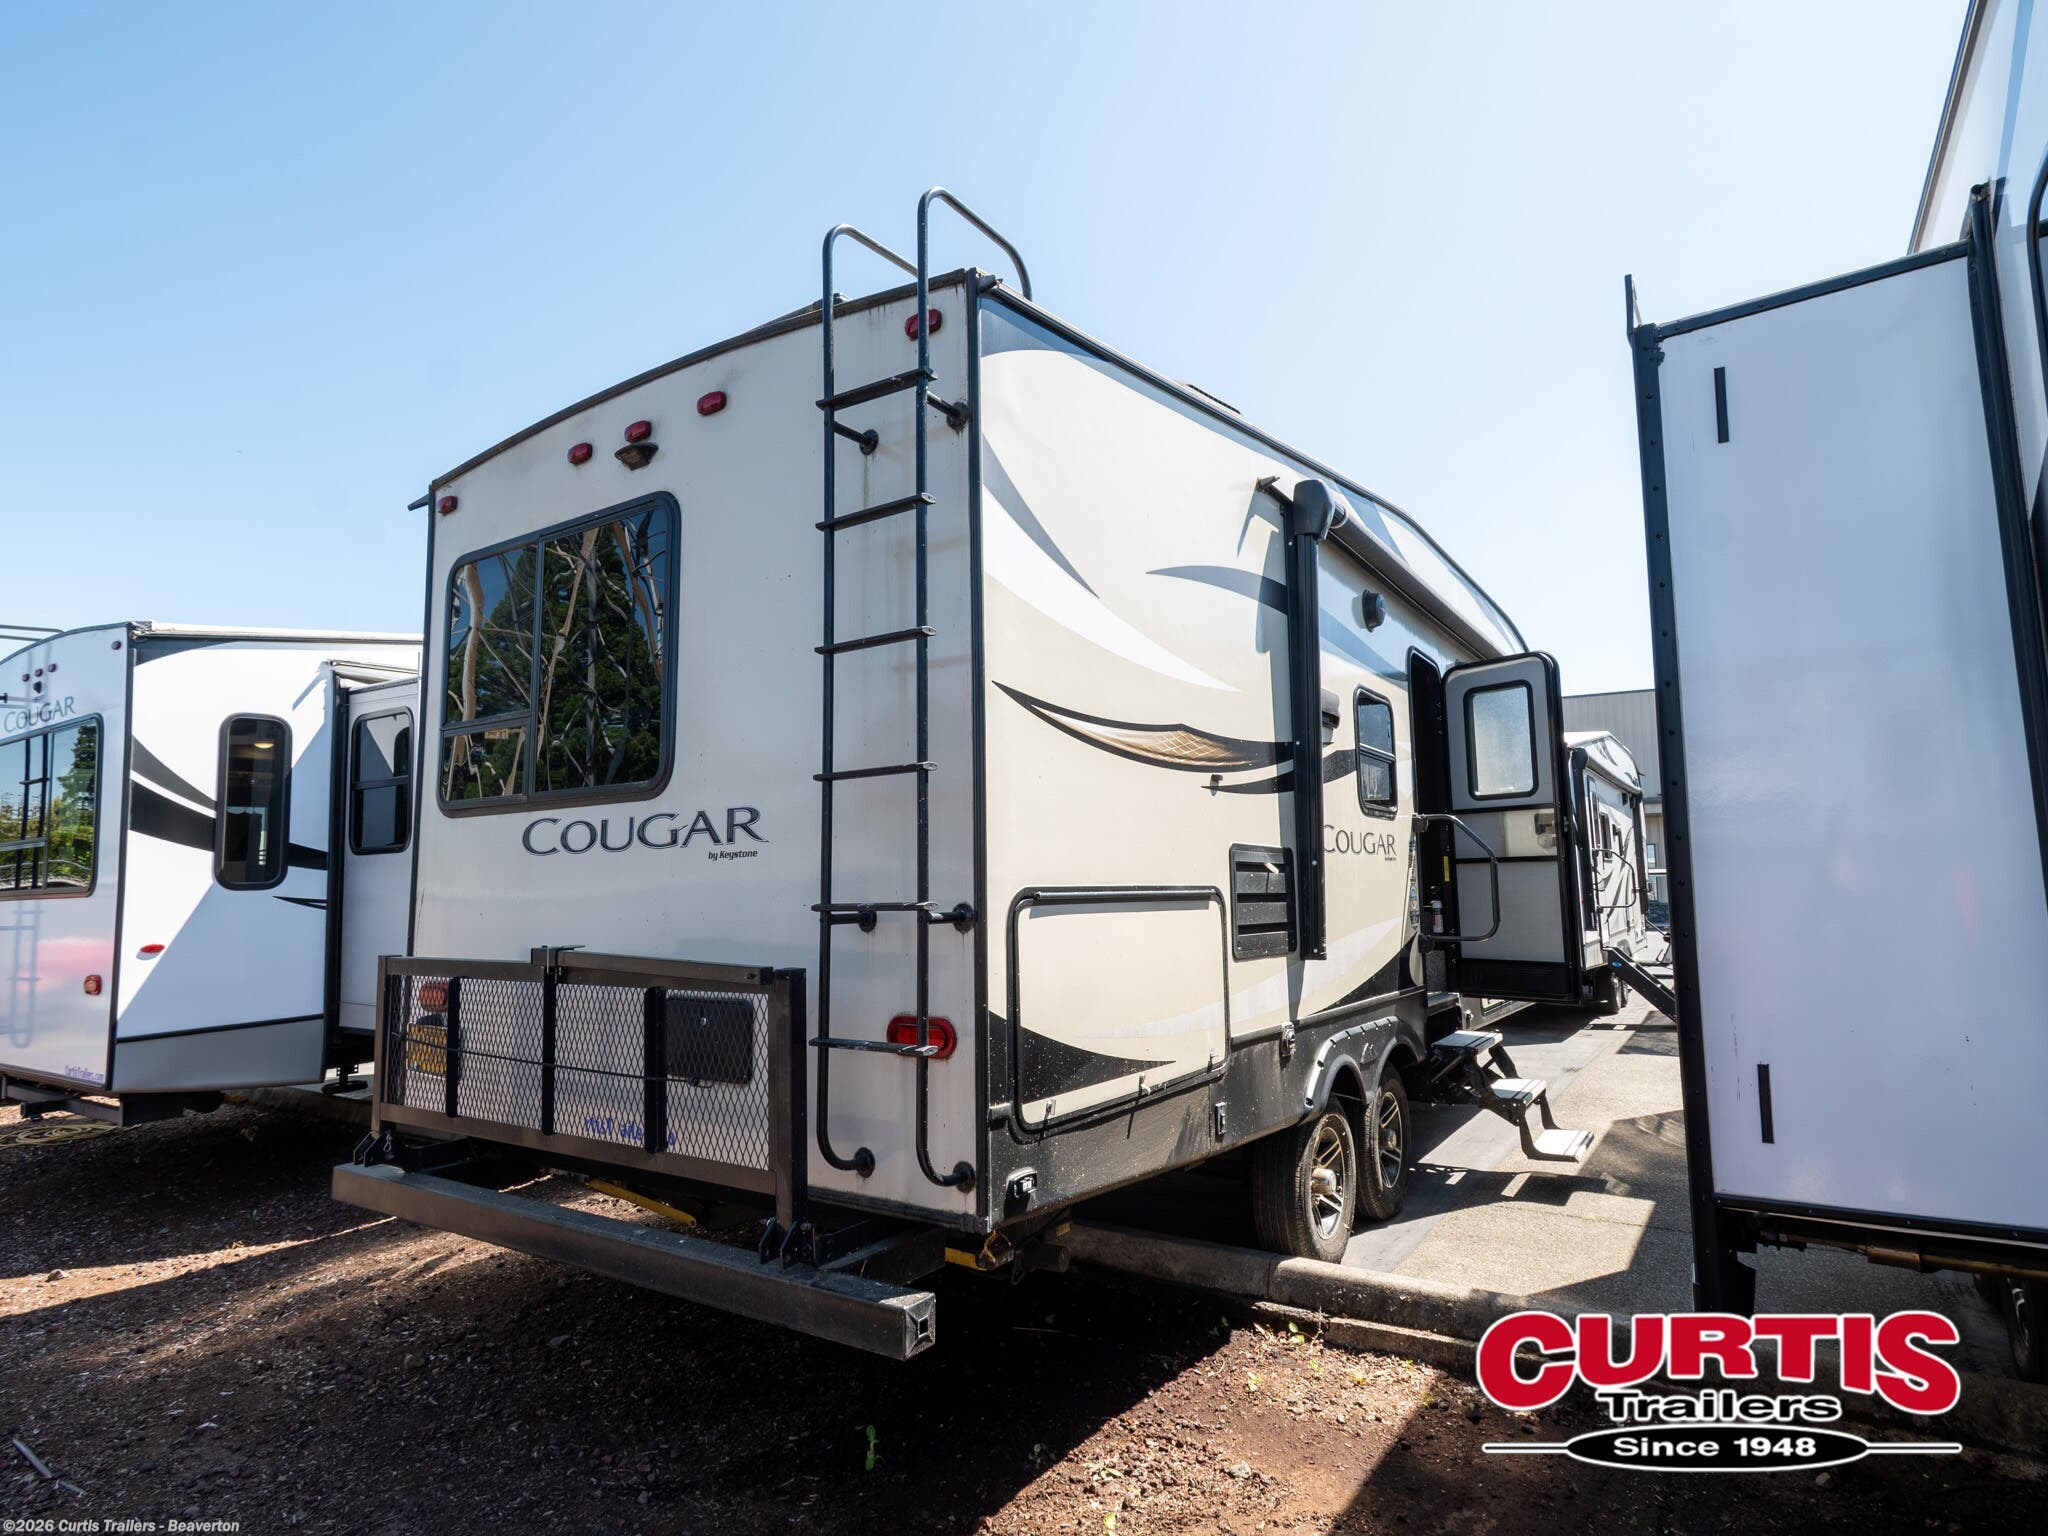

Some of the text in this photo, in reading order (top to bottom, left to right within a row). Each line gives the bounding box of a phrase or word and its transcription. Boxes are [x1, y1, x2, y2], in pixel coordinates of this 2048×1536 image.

[4, 696, 76, 732] COUGAR
[522, 806, 769, 856] COUGAR
[708, 850, 758, 861] by Keystone
